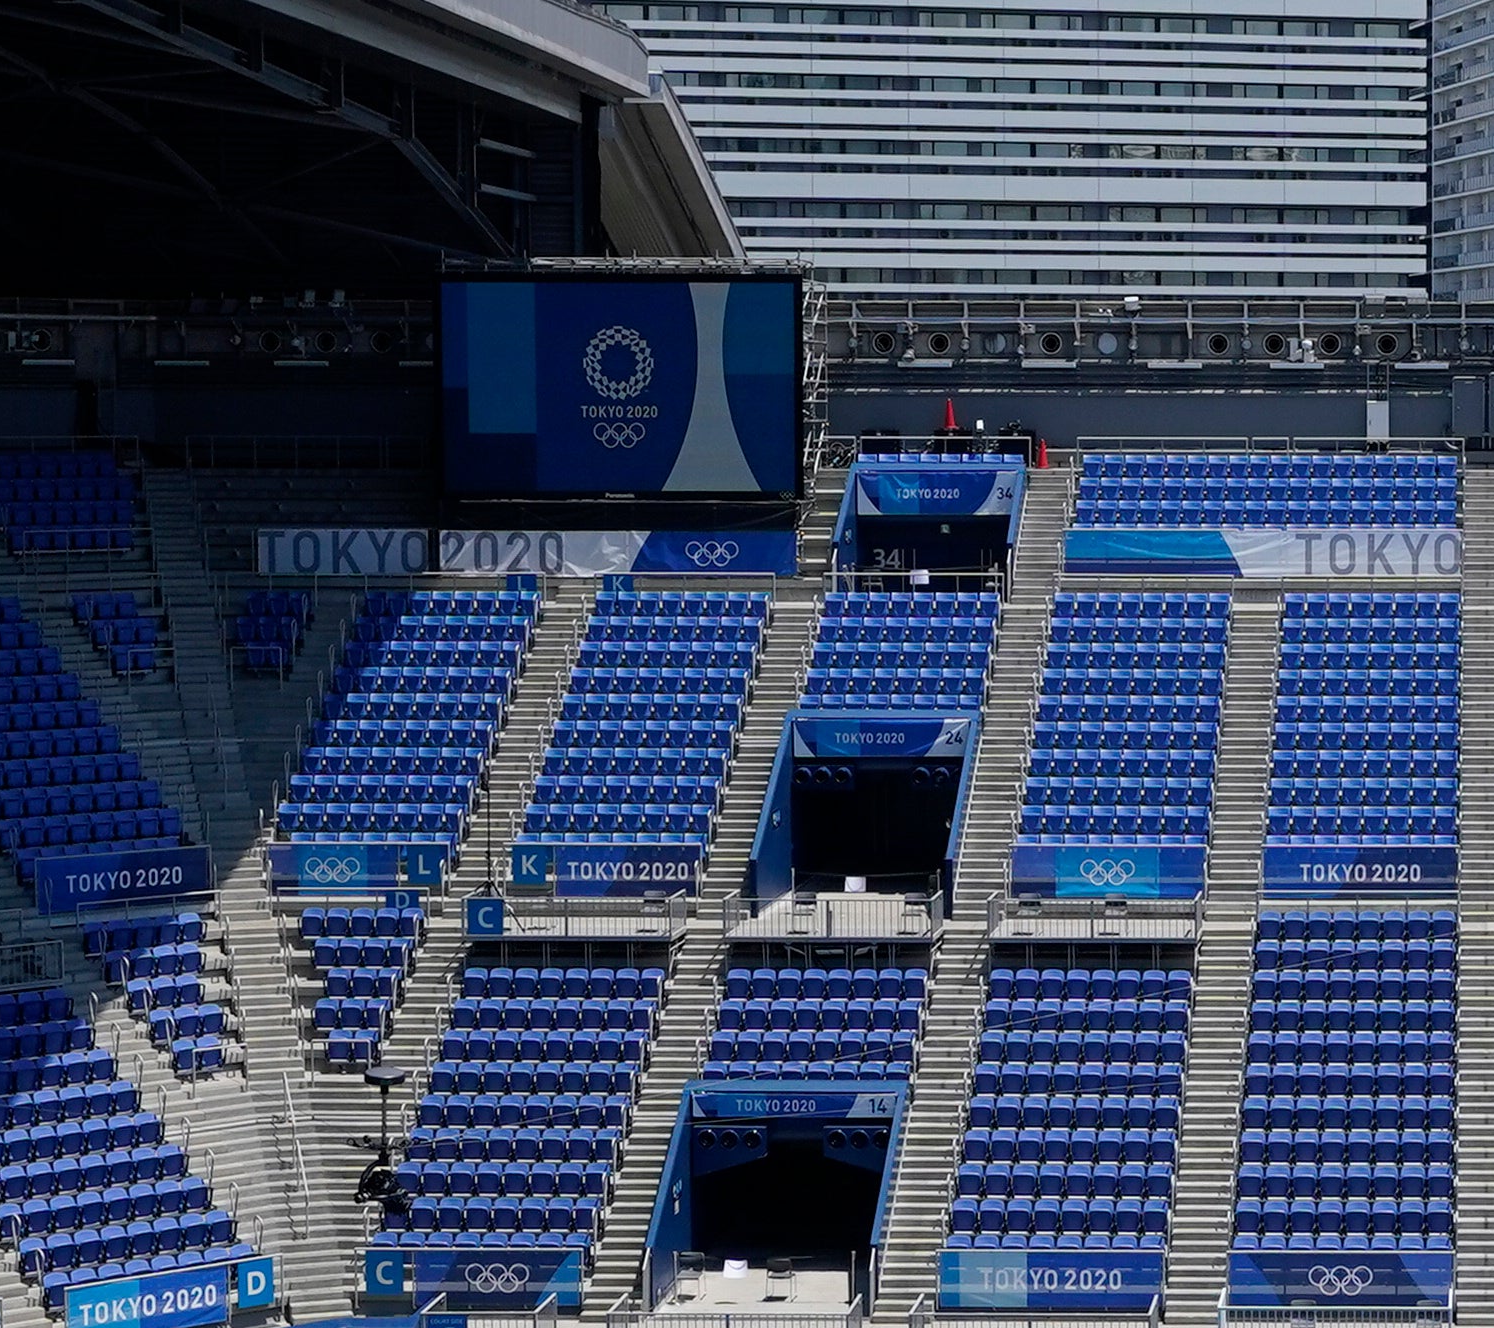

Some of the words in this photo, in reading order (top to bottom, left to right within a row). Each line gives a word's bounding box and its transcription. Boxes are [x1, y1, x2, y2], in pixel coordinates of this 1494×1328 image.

[581, 406, 625, 419] TOKYO
[626, 405, 659, 419] 2020
[896, 488, 931, 500] TOKYO
[932, 488, 961, 500] 2020
[997, 487, 1013, 500] 34
[259, 531, 430, 574] TOKYO
[441, 531, 565, 574] 2020
[1296, 533, 1460, 576] TOKYO
[834, 733, 873, 745] TOKYO
[876, 733, 905, 745] 2020
[946, 732, 963, 745] 24
[419, 855, 431, 874] L
[522, 855, 538, 875] K
[567, 861, 634, 882] TOKYO
[639, 861, 689, 882] 2020
[1299, 862, 1367, 883] TOKYO
[1371, 862, 1422, 883] 2020
[65, 868, 131, 895] TOKYO
[135, 865, 184, 888] 2020
[396, 892, 410, 908] D
[478, 908, 493, 929] C
[736, 1099, 779, 1112] TOKYO
[783, 1099, 816, 1112] 2020
[869, 1098, 887, 1114] 14
[376, 1261, 394, 1284] C
[980, 1268, 1058, 1291] TOKYO
[1065, 1268, 1122, 1291] 2020
[248, 1272, 266, 1295] D
[80, 1293, 156, 1325] TOKYO
[161, 1285, 217, 1315] 2020
